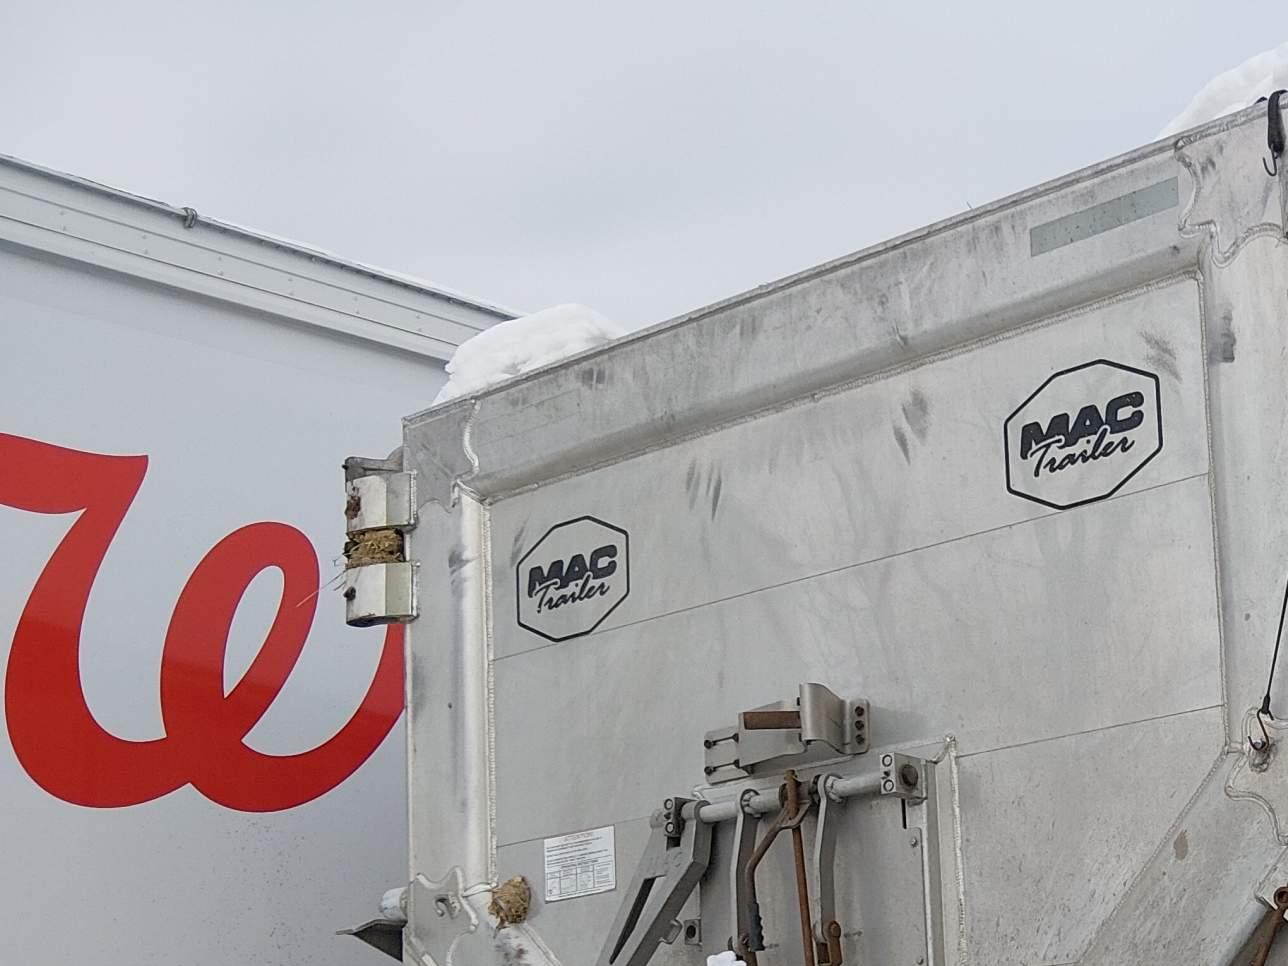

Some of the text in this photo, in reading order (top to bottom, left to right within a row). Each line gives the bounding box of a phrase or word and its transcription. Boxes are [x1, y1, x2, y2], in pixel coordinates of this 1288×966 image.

[1020, 391, 1144, 460] MAC
[1029, 427, 1135, 477] Trailer
[528, 544, 617, 599] MAC
[534, 574, 610, 614] Trailer
